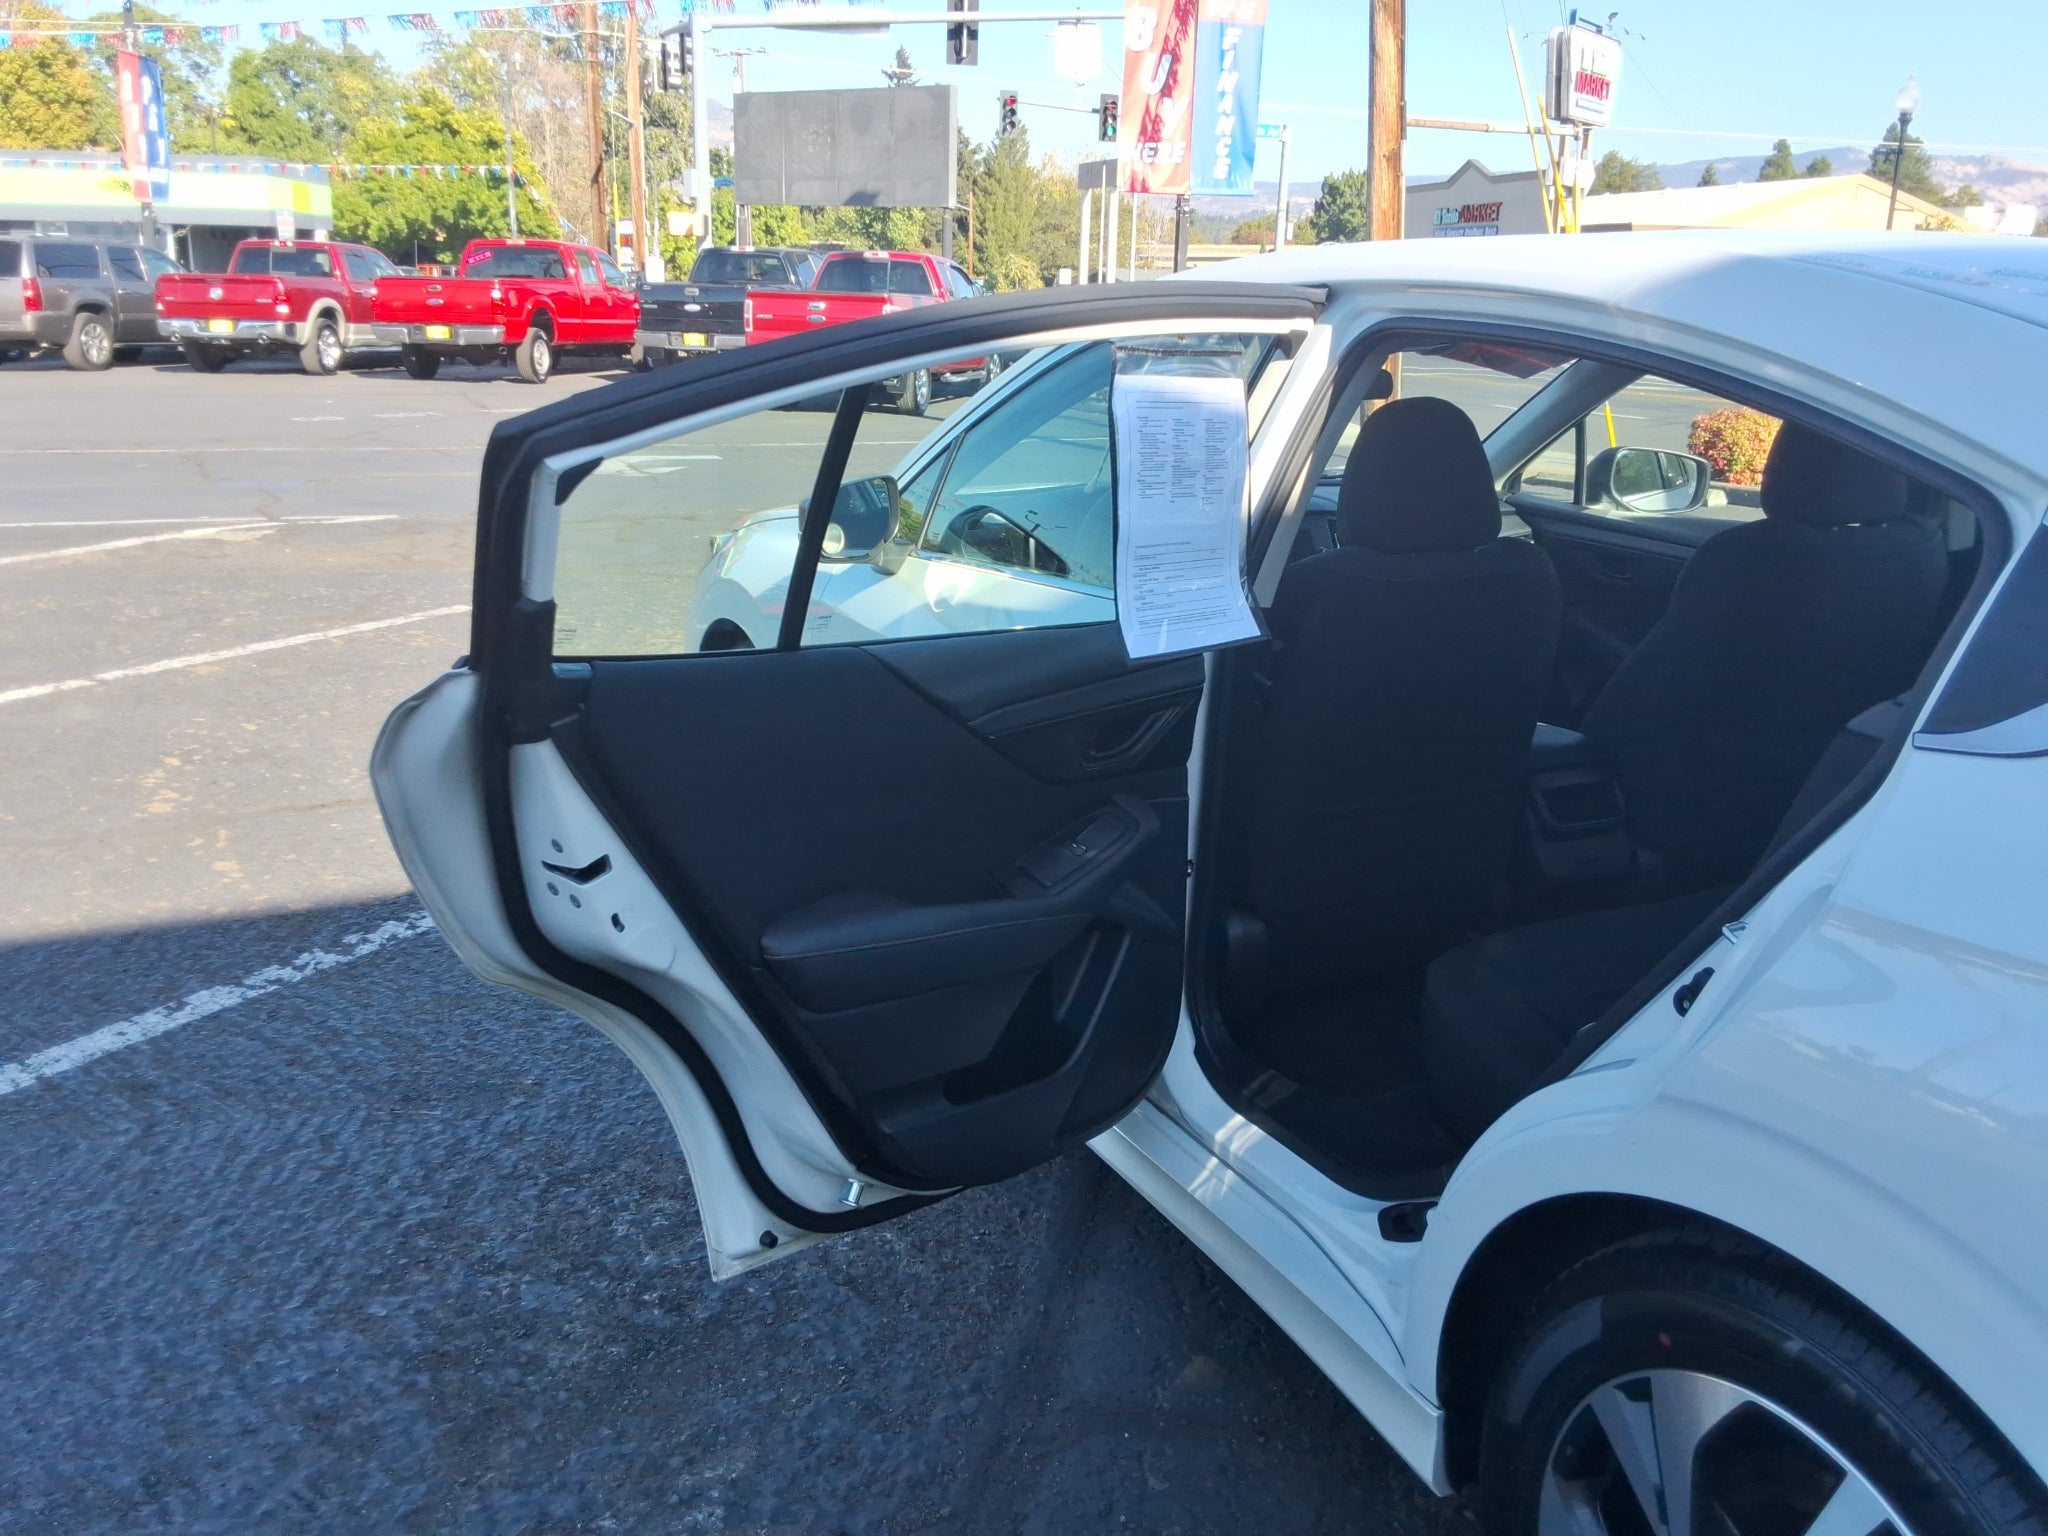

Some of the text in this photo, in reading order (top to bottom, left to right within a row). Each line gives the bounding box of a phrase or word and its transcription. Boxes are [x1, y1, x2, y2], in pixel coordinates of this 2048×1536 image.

[1125, 6, 1190, 140] BUY
[1574, 71, 1613, 101] MARKET
[1213, 27, 1243, 181] FINANCE
[1121, 142, 1187, 165] HERE
[1460, 202, 1503, 224] MARKET
